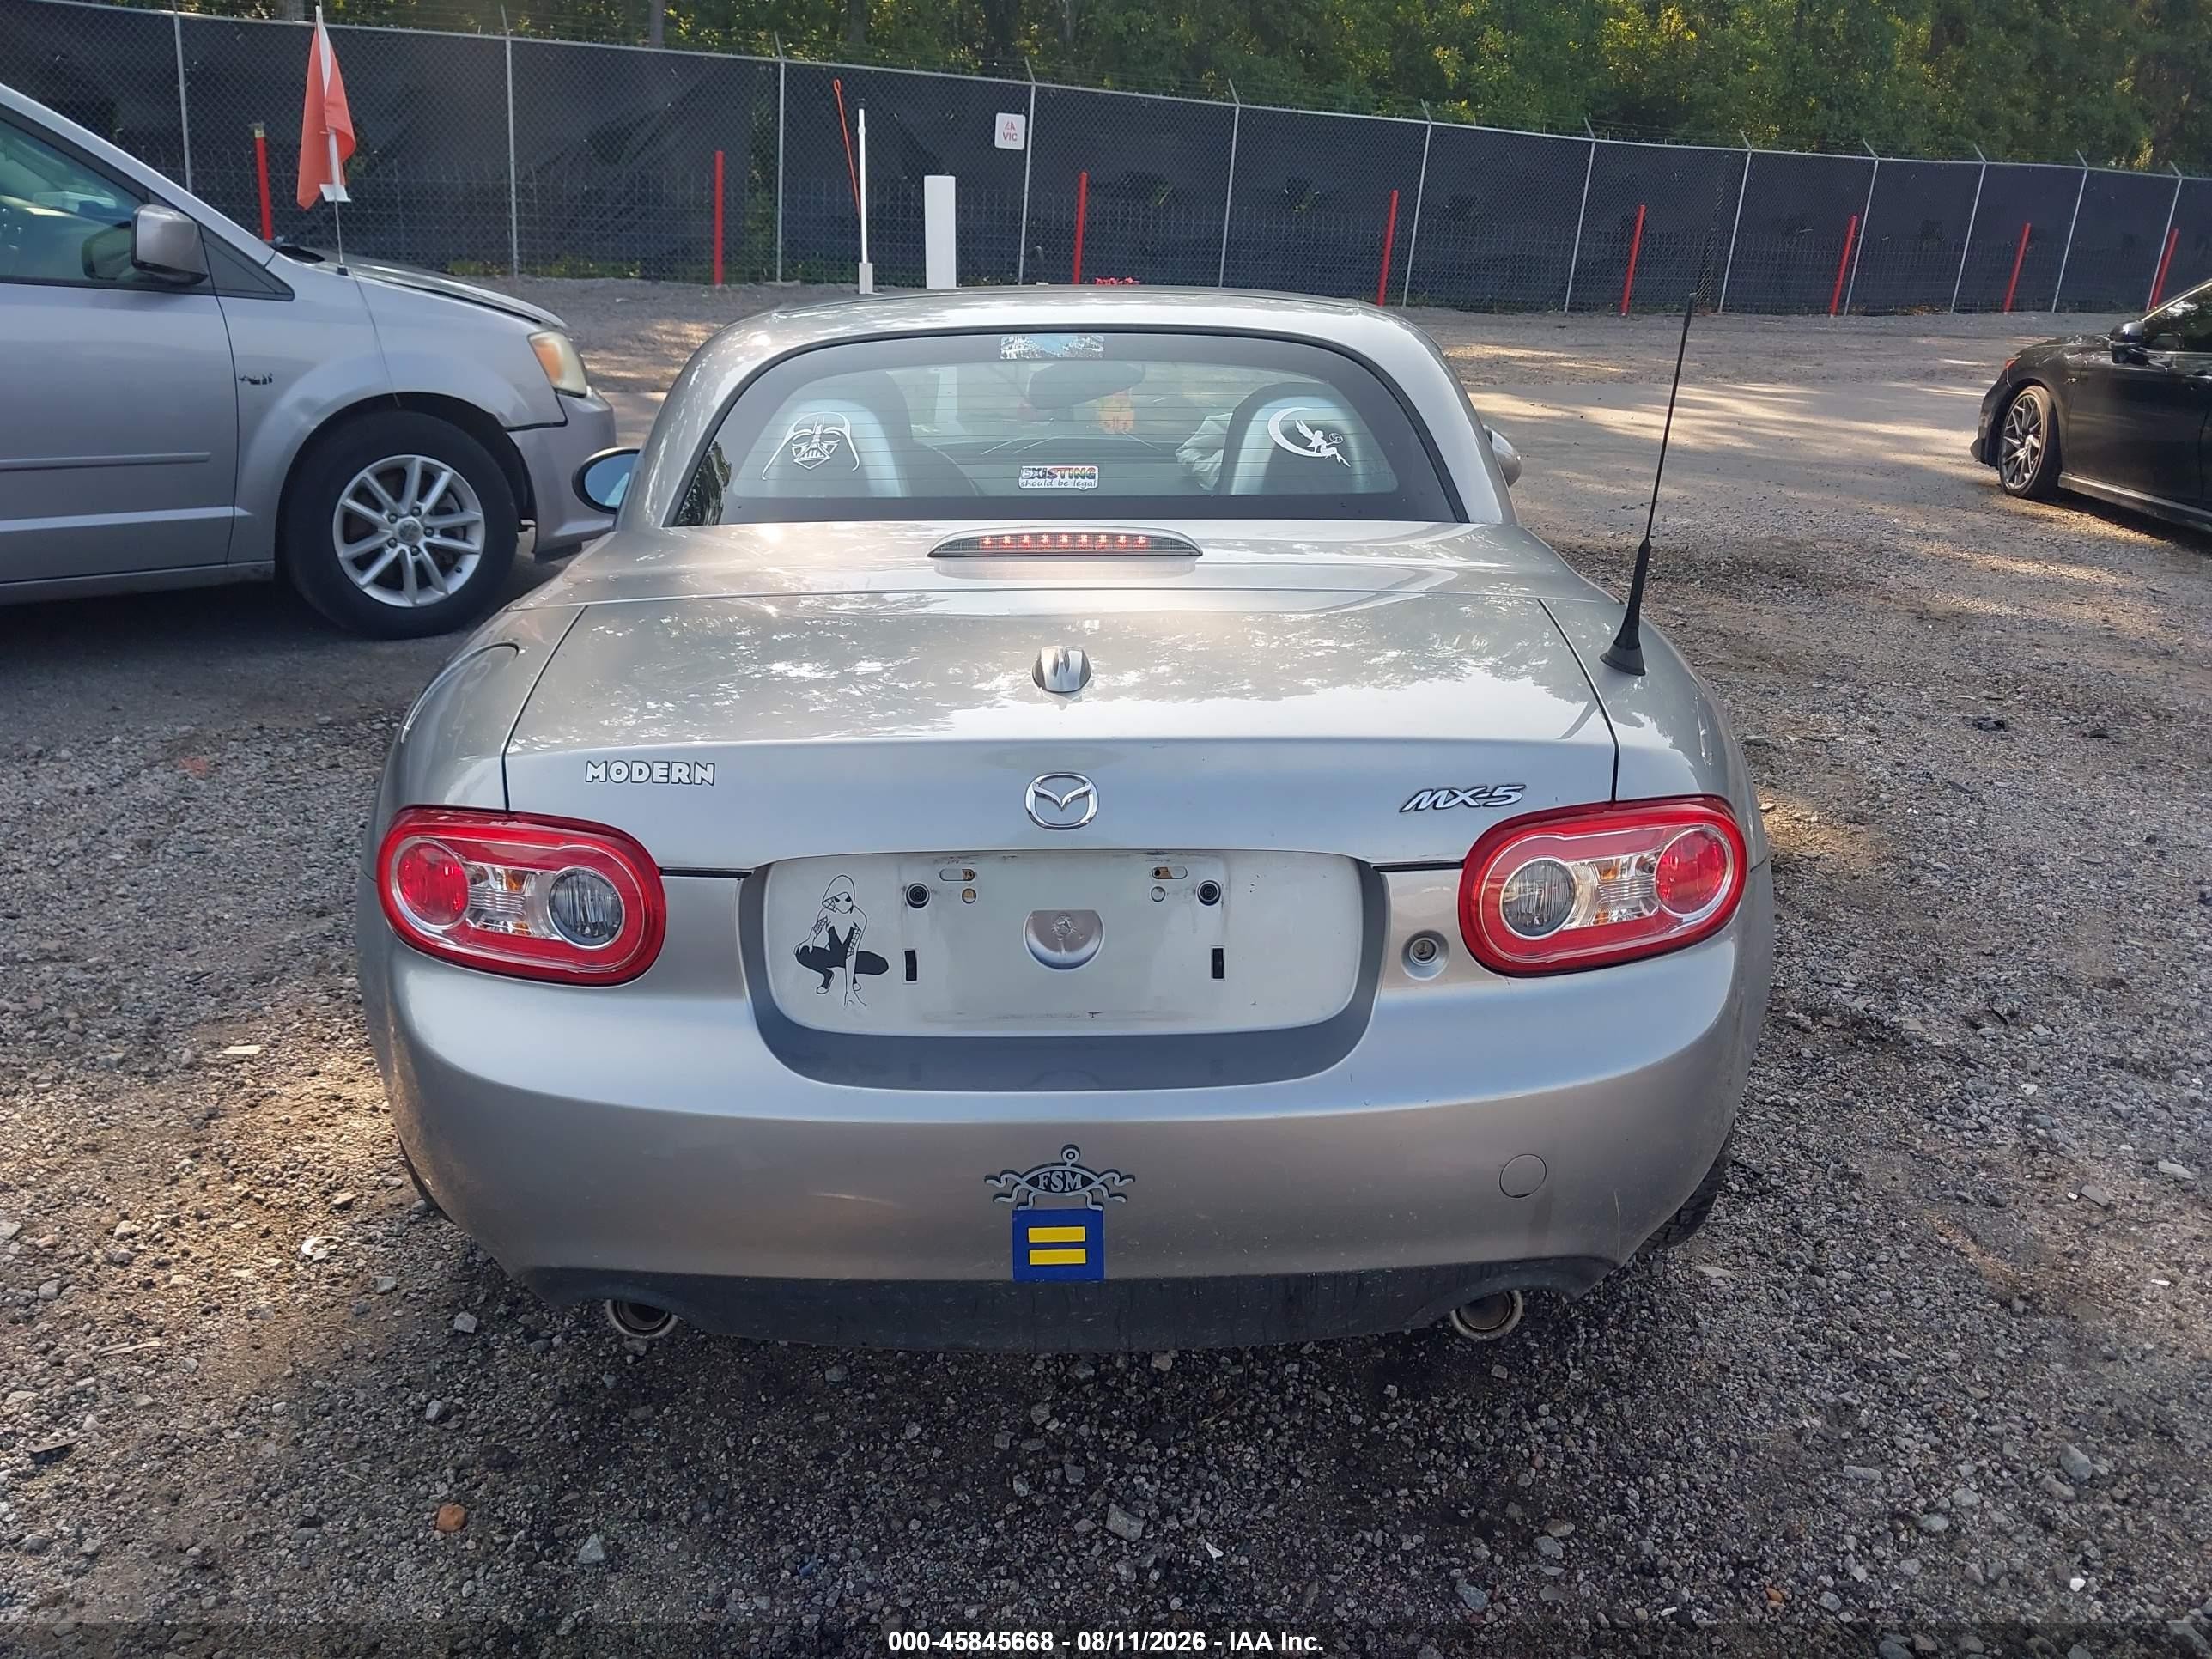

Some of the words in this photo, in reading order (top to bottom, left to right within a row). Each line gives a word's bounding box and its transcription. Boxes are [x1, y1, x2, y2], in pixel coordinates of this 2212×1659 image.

[1002, 131, 1018, 142] VIC
[1021, 467, 1096, 479] EXISTING
[1073, 479, 1096, 489] legal
[585, 760, 715, 786] MODERN
[1399, 784, 1526, 813] MX-5
[1037, 1171, 1083, 1192] FSM
